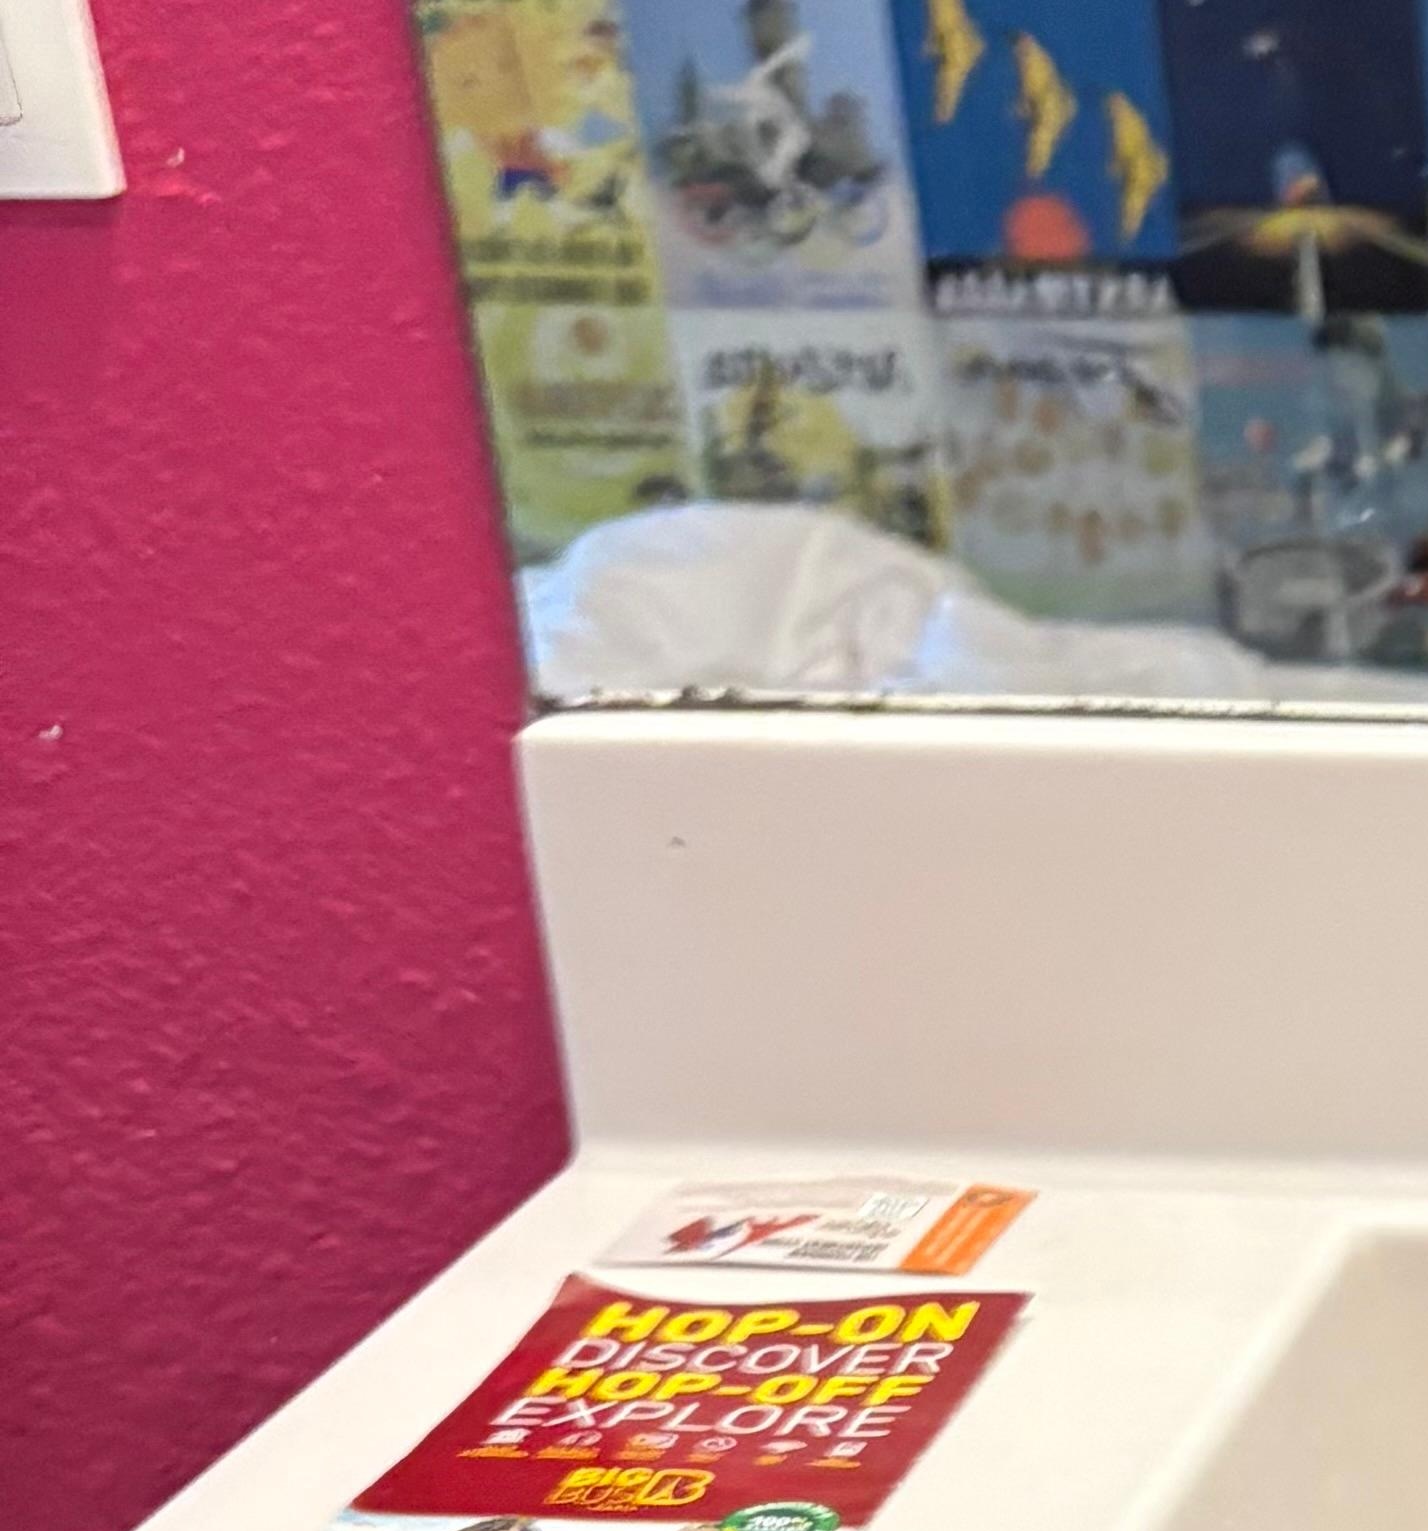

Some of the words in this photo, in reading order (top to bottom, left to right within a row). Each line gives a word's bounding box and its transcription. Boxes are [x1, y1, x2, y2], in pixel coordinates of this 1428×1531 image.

[583, 1301, 981, 1345] HOP-ON
[554, 1337, 954, 1375] DISCOVER
[527, 1366, 936, 1406] HOP-OFF
[490, 1396, 912, 1438] EXPLORE
[565, 1467, 655, 1487] BIG
